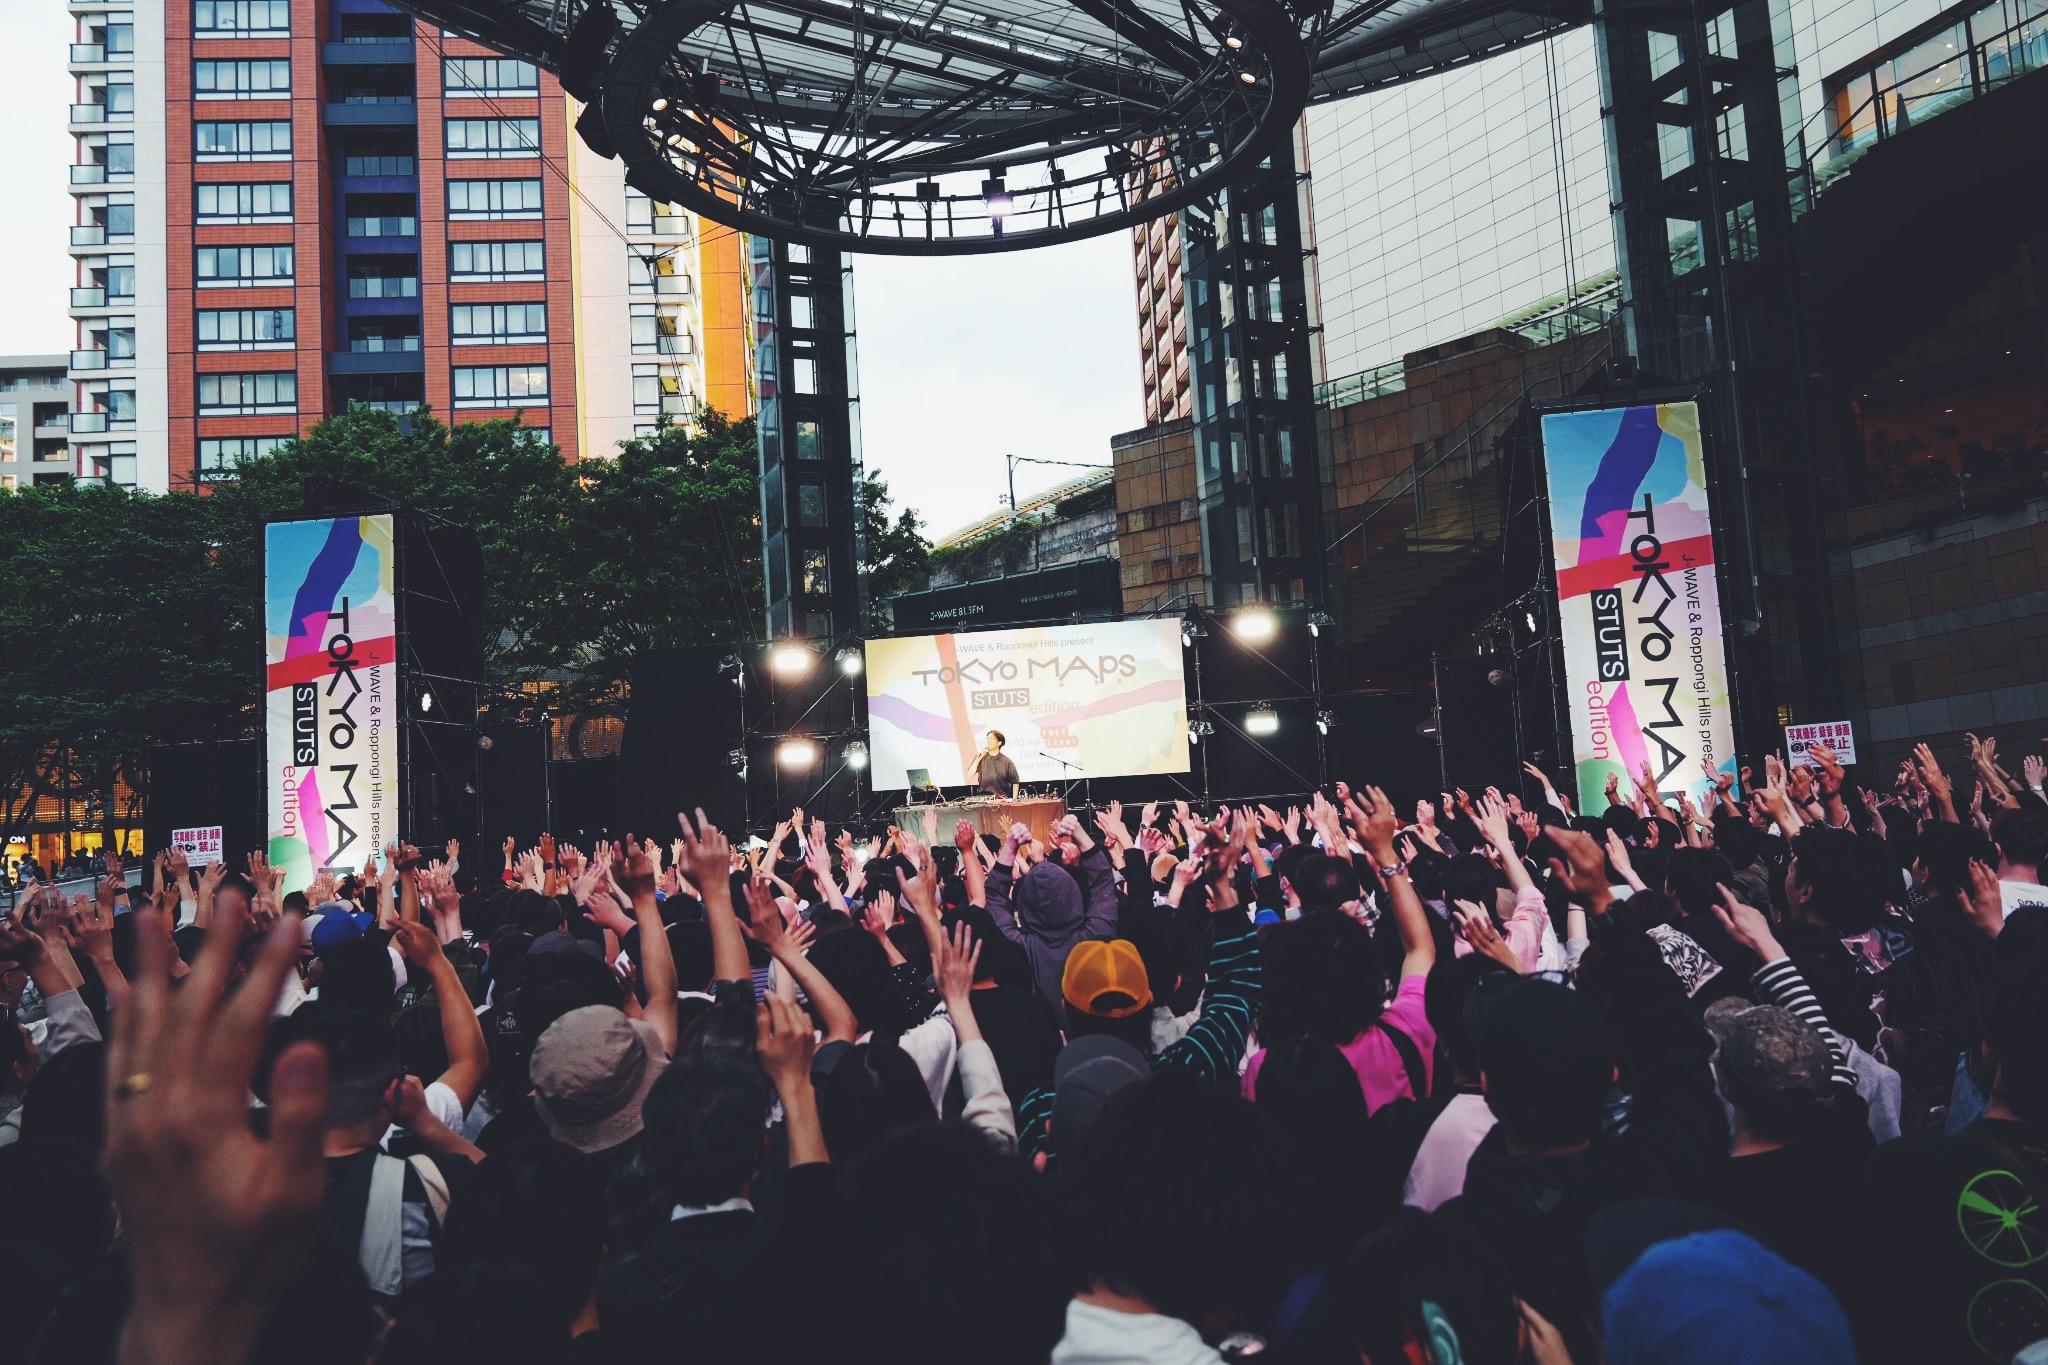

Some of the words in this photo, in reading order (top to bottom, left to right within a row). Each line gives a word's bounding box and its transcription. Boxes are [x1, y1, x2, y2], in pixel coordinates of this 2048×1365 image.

[1627, 493, 1677, 661] TOKYO
[1682, 554, 1700, 608] J-WAVE
[930, 608, 957, 620] J-WAVE
[1688, 613, 1702, 624] &
[987, 643, 994, 652] &
[997, 639, 1038, 653] Roppongi
[1040, 638, 1058, 648] Hills
[1060, 636, 1094, 648] present
[1596, 594, 1625, 678] STUTS
[326, 597, 362, 749] TOKYO
[369, 652, 381, 703] J-WAVE
[912, 658, 1018, 686] TOKYO
[1690, 628, 1706, 697] Roppongi
[370, 706, 381, 716] &
[974, 689, 1028, 707] STUTS
[1029, 699, 1080, 714] edition
[1698, 697, 1713, 727] Hills
[297, 687, 315, 762] STUTS
[1586, 681, 1612, 760] edition
[369, 719, 381, 779] Roppongi
[1823, 737, 1850, 750] 禁止
[283, 765, 300, 837] edition
[371, 783, 382, 809] Hills
[198, 840, 219, 852] 禁止
